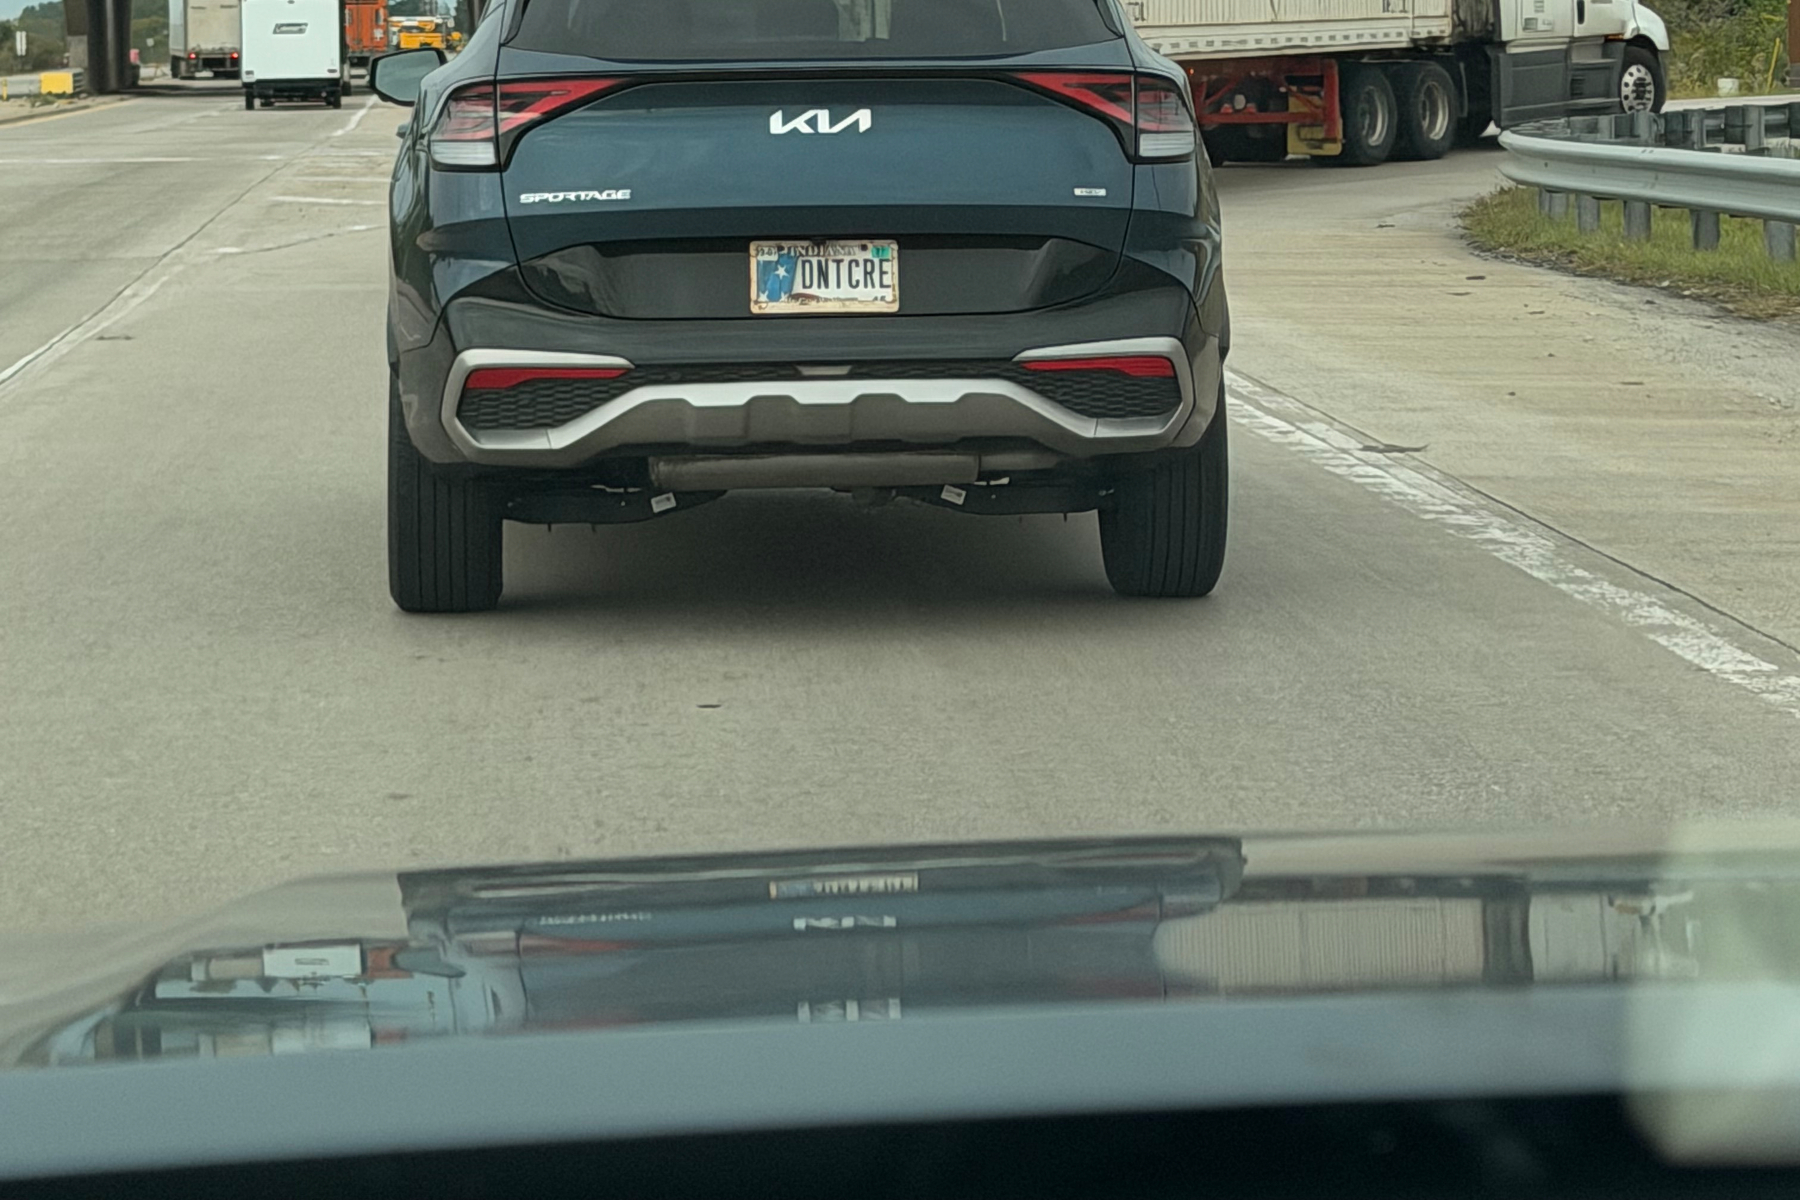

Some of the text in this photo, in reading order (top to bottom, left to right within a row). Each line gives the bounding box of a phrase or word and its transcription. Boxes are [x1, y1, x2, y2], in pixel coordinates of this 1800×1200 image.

[769, 109, 872, 134] KIA
[520, 189, 631, 203] SPORTAGE
[801, 258, 892, 290] DNTCRE
